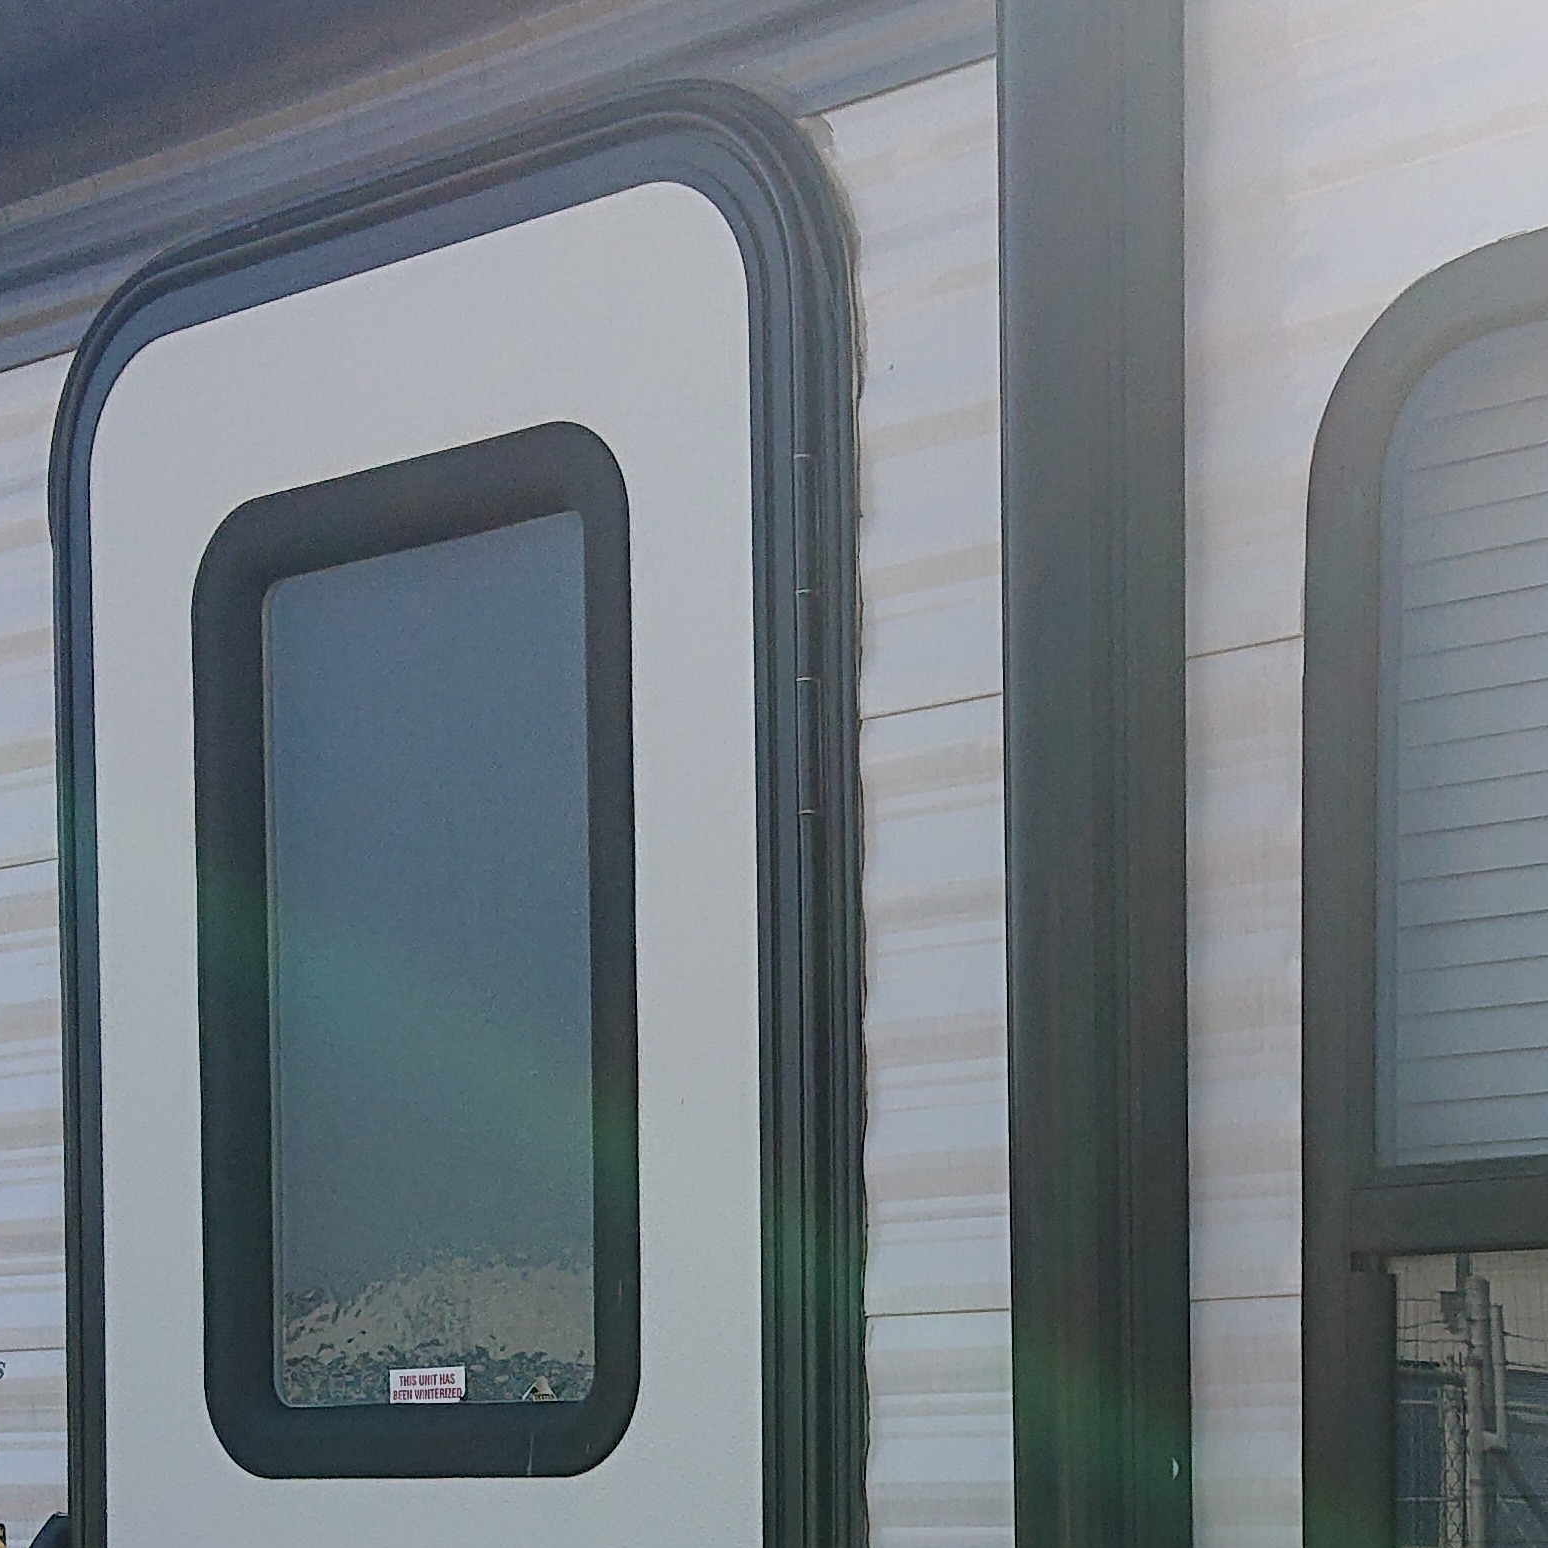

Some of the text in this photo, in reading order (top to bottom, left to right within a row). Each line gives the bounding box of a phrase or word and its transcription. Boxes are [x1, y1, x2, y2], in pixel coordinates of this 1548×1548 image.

[399, 1373, 456, 1387] THIS UNIT HAS
[393, 1387, 463, 1401] BEEN WINTERIZED
